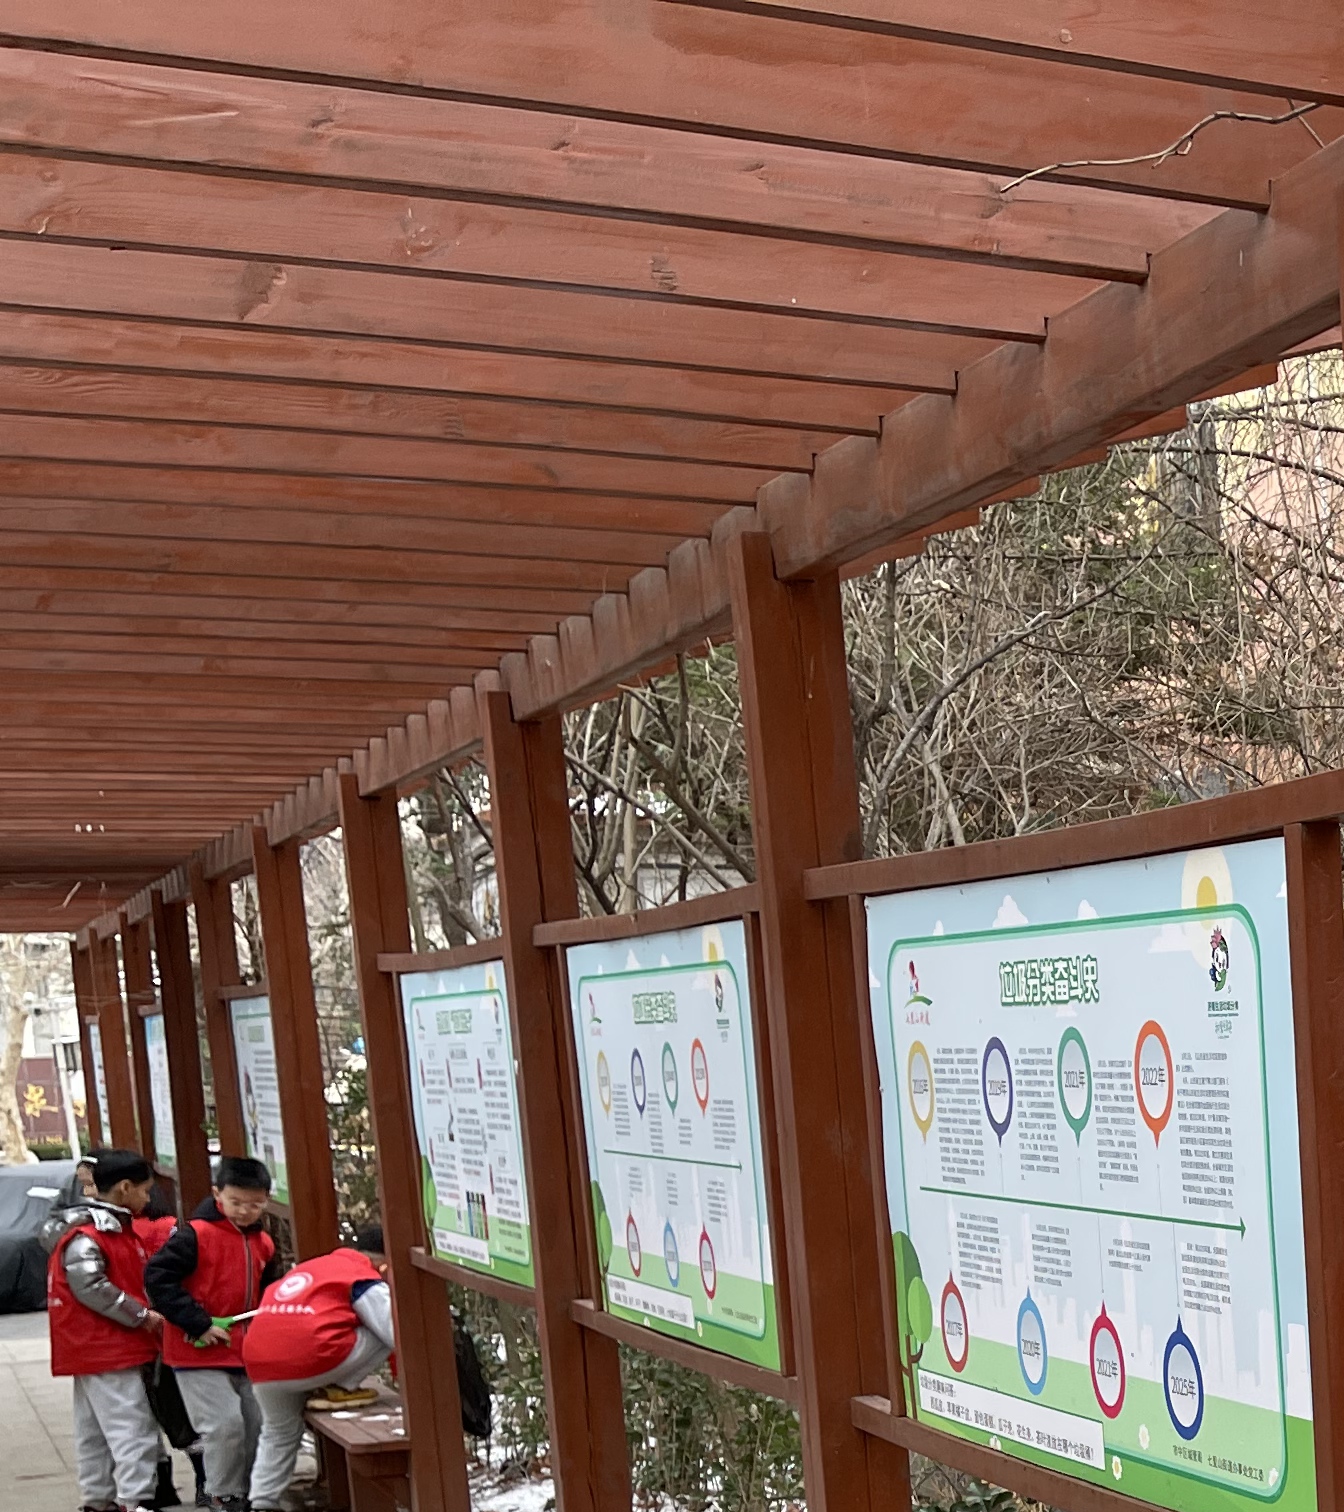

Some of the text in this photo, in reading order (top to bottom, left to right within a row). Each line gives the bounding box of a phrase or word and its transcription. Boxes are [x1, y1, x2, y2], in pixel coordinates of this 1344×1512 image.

[999, 954, 1099, 1006] 垃圾分类奋斗史
[1064, 1069, 1086, 1089] 2021年
[1141, 1066, 1166, 1087] 2022年
[1096, 1357, 1118, 1380] 2021年
[1170, 1375, 1196, 1399] 2025年
